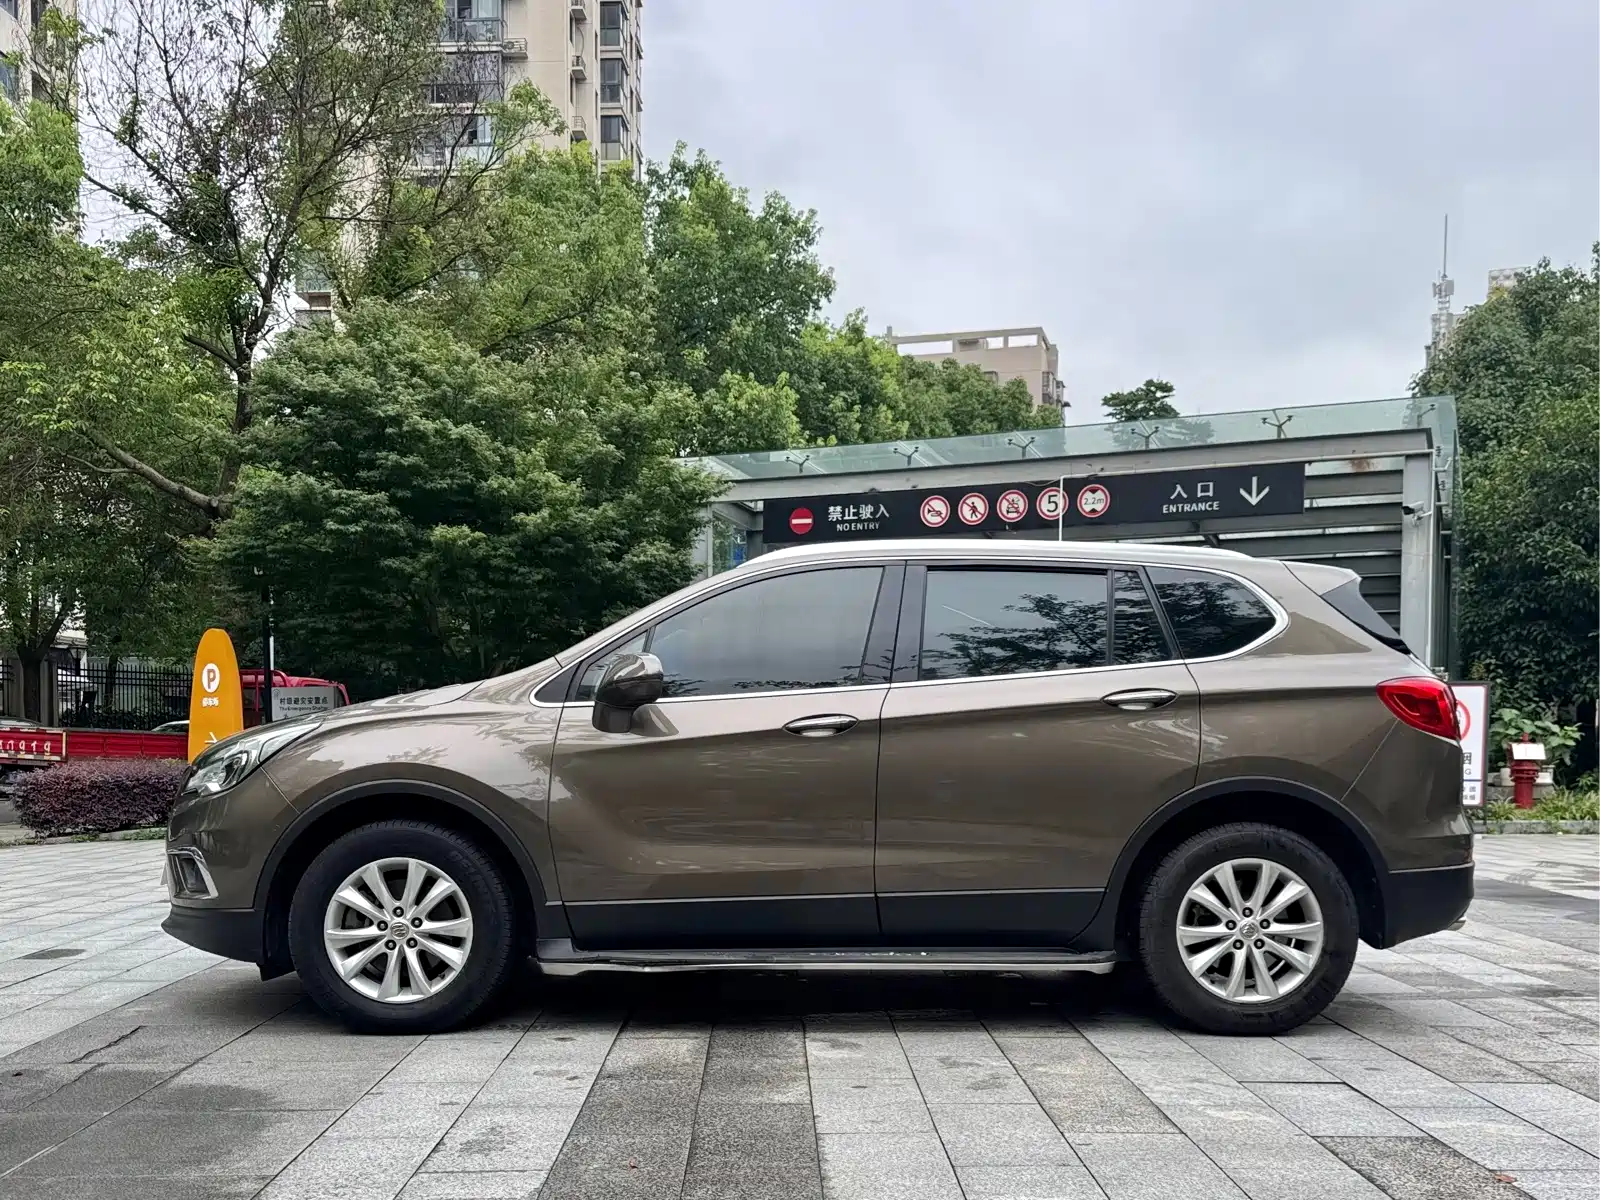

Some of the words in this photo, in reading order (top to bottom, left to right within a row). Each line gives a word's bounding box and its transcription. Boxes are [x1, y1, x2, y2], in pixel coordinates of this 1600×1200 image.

[1169, 481, 1214, 500] 入口
[1046, 494, 1059, 513] 5
[1083, 496, 1105, 506] 2.2m
[1162, 501, 1220, 514] ENTRANCE
[828, 503, 890, 522] 禁止驶入
[836, 523, 850, 532] NO
[851, 521, 880, 531] ENTRY
[207, 668, 216, 690] P
